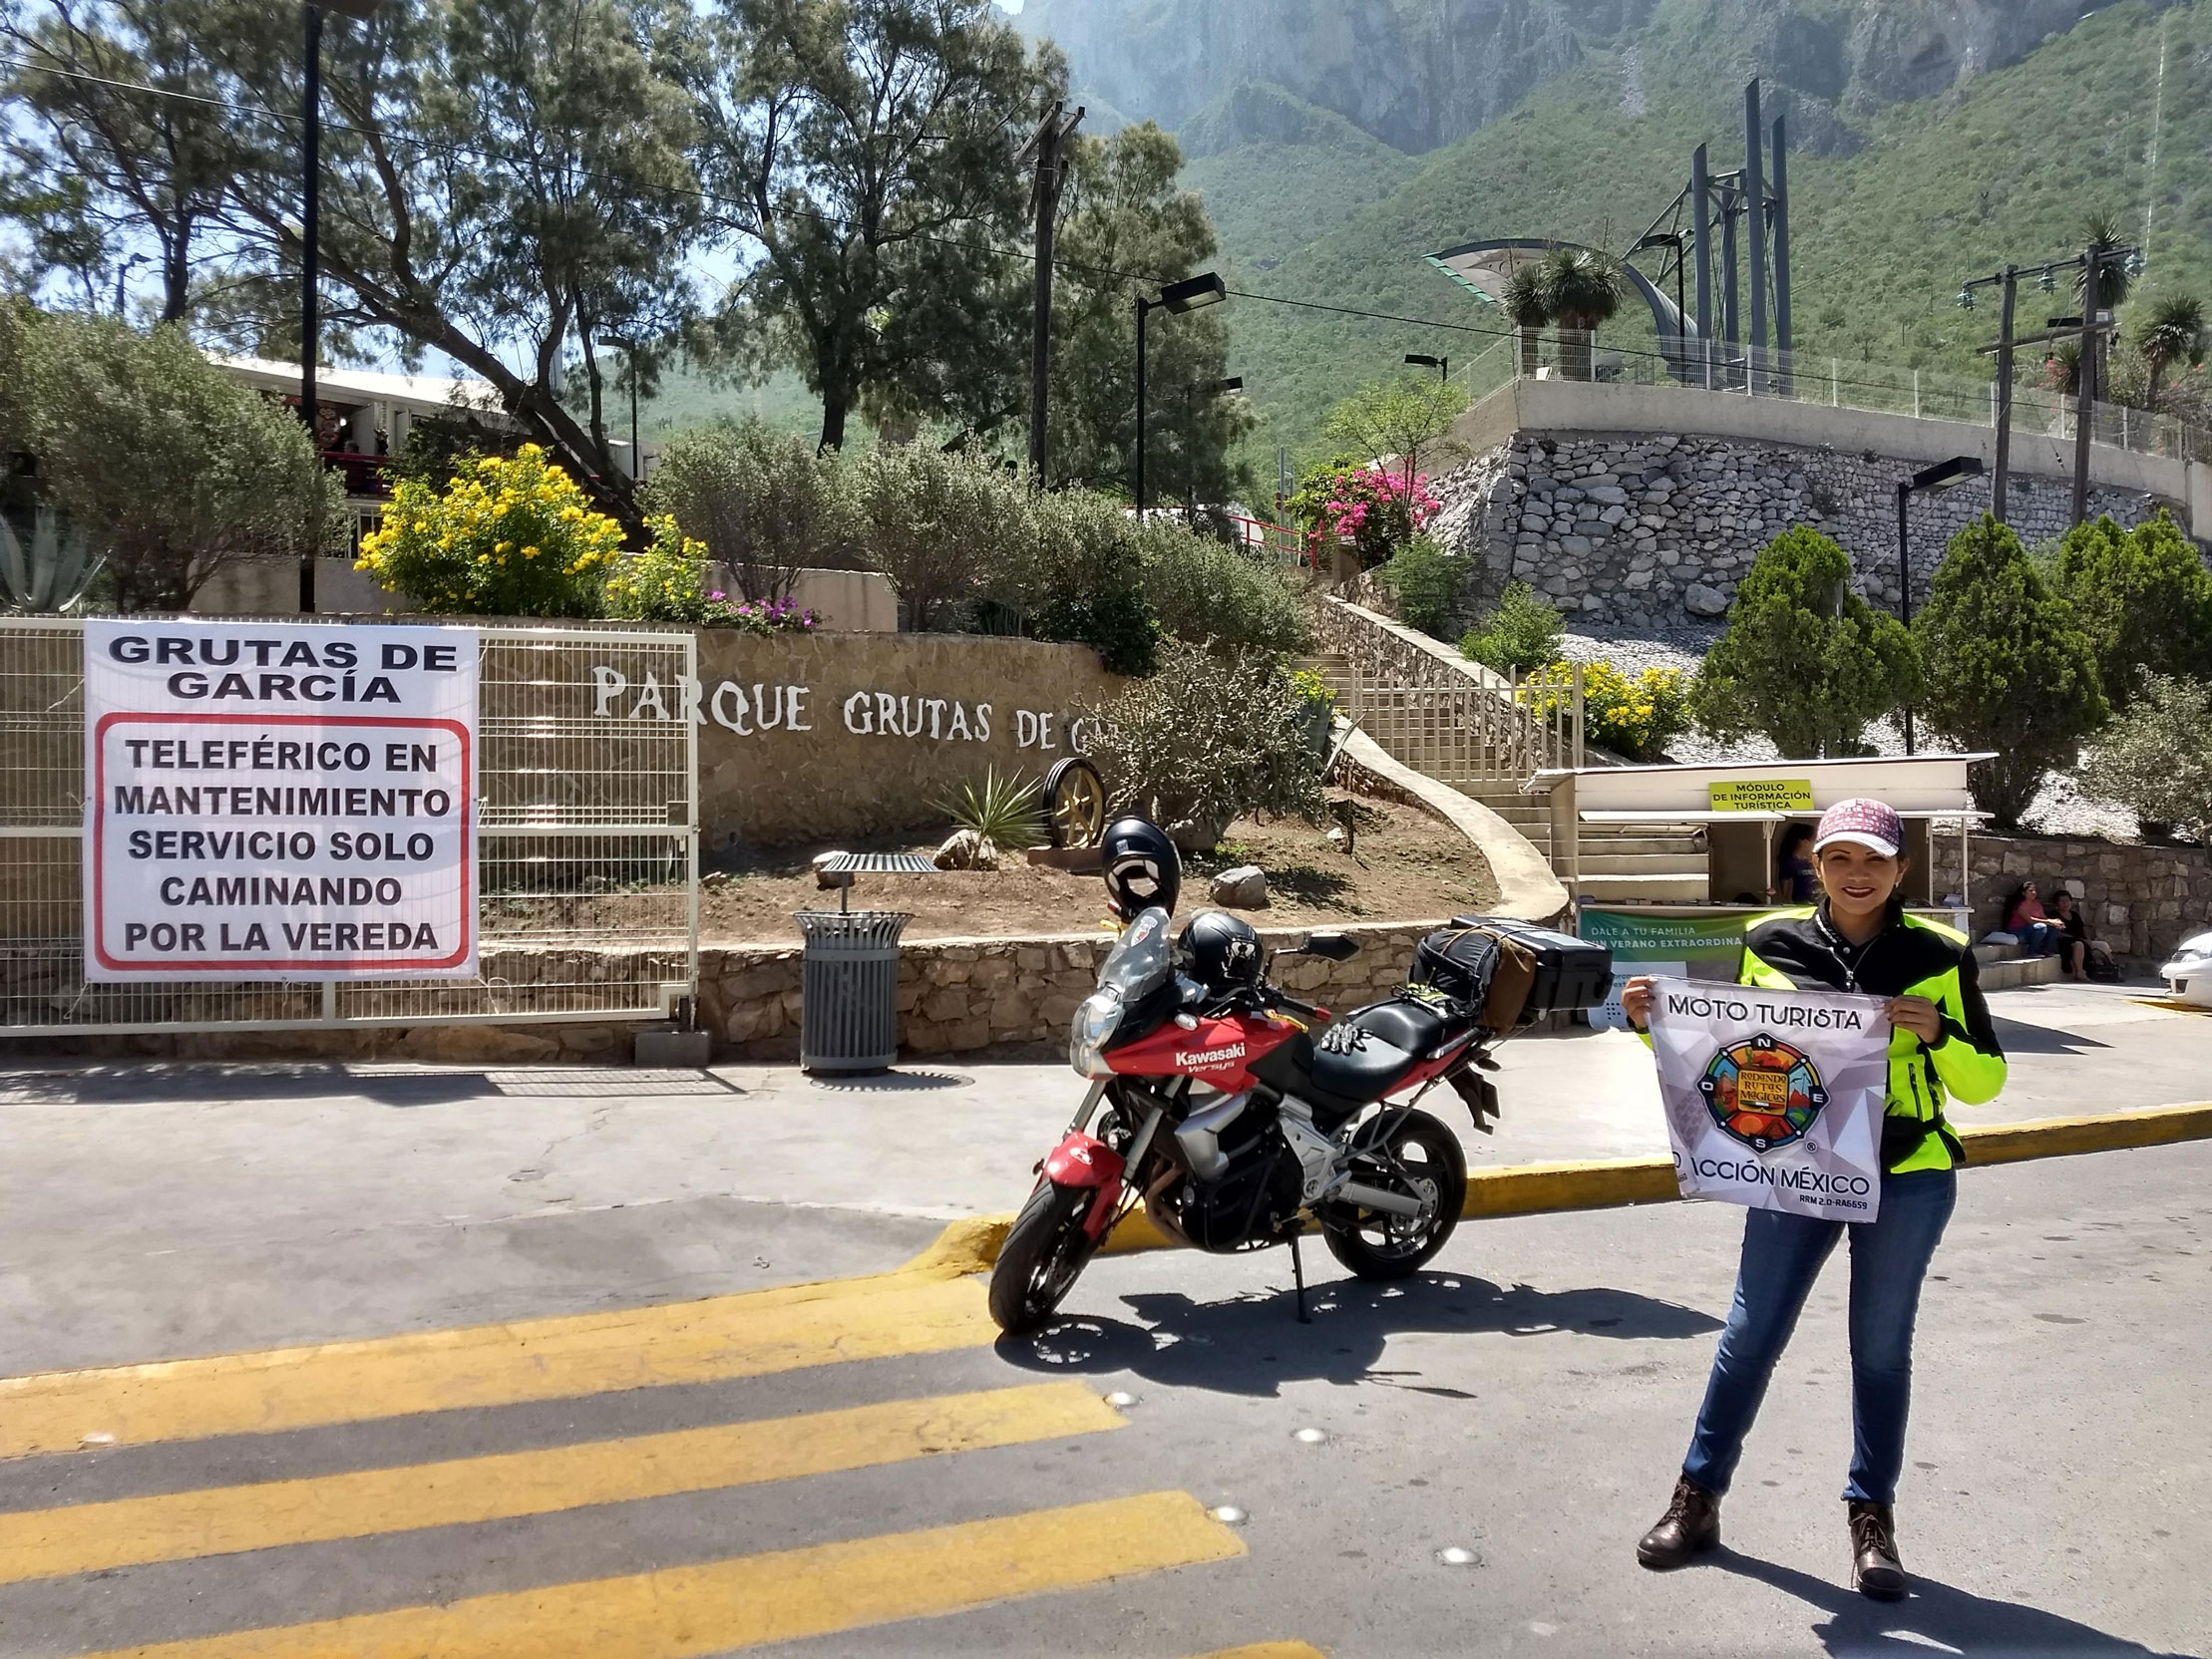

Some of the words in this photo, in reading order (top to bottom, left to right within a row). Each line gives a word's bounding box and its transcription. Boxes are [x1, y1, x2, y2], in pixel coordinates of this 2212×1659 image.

[109, 636, 358, 670] GRUTAS
[381, 643, 457, 672] DE
[168, 669, 402, 704] GARCÍA
[592, 666, 813, 736] PARQUE
[844, 691, 992, 742] GRUTAS
[1016, 709, 1056, 750] DE
[125, 734, 371, 772] TELEFÉRICO
[385, 743, 437, 773] EN
[1730, 791, 1811, 801] INFORMACIÓN
[1736, 783, 1785, 792] MÓDULO
[114, 786, 451, 818] MANTENIMIENTO
[1734, 801, 1792, 810] TURÍSTICA
[128, 830, 316, 860] SERVICIO
[329, 831, 434, 861] SOLO
[160, 876, 402, 906] CAMINANDO
[125, 921, 206, 952] POR
[219, 922, 270, 951] LA
[281, 921, 439, 952] VEREDA
[1591, 927, 1619, 936] DALE
[1622, 927, 1630, 936] A
[1633, 927, 1648, 936] TU
[1659, 937, 1742, 947] EXTRAORDINA
[1667, 994, 1749, 1021] MOTO
[1756, 1003, 1862, 1030] TURISTA
[1176, 1042, 1246, 1067] Kawasaki
[1757, 1038, 1771, 1048] N
[1813, 1093, 1824, 1104] E
[1755, 1138, 1766, 1149] S
[1780, 1165, 1871, 1195] MÉXICO
[1799, 1194, 1818, 1205] RRM
